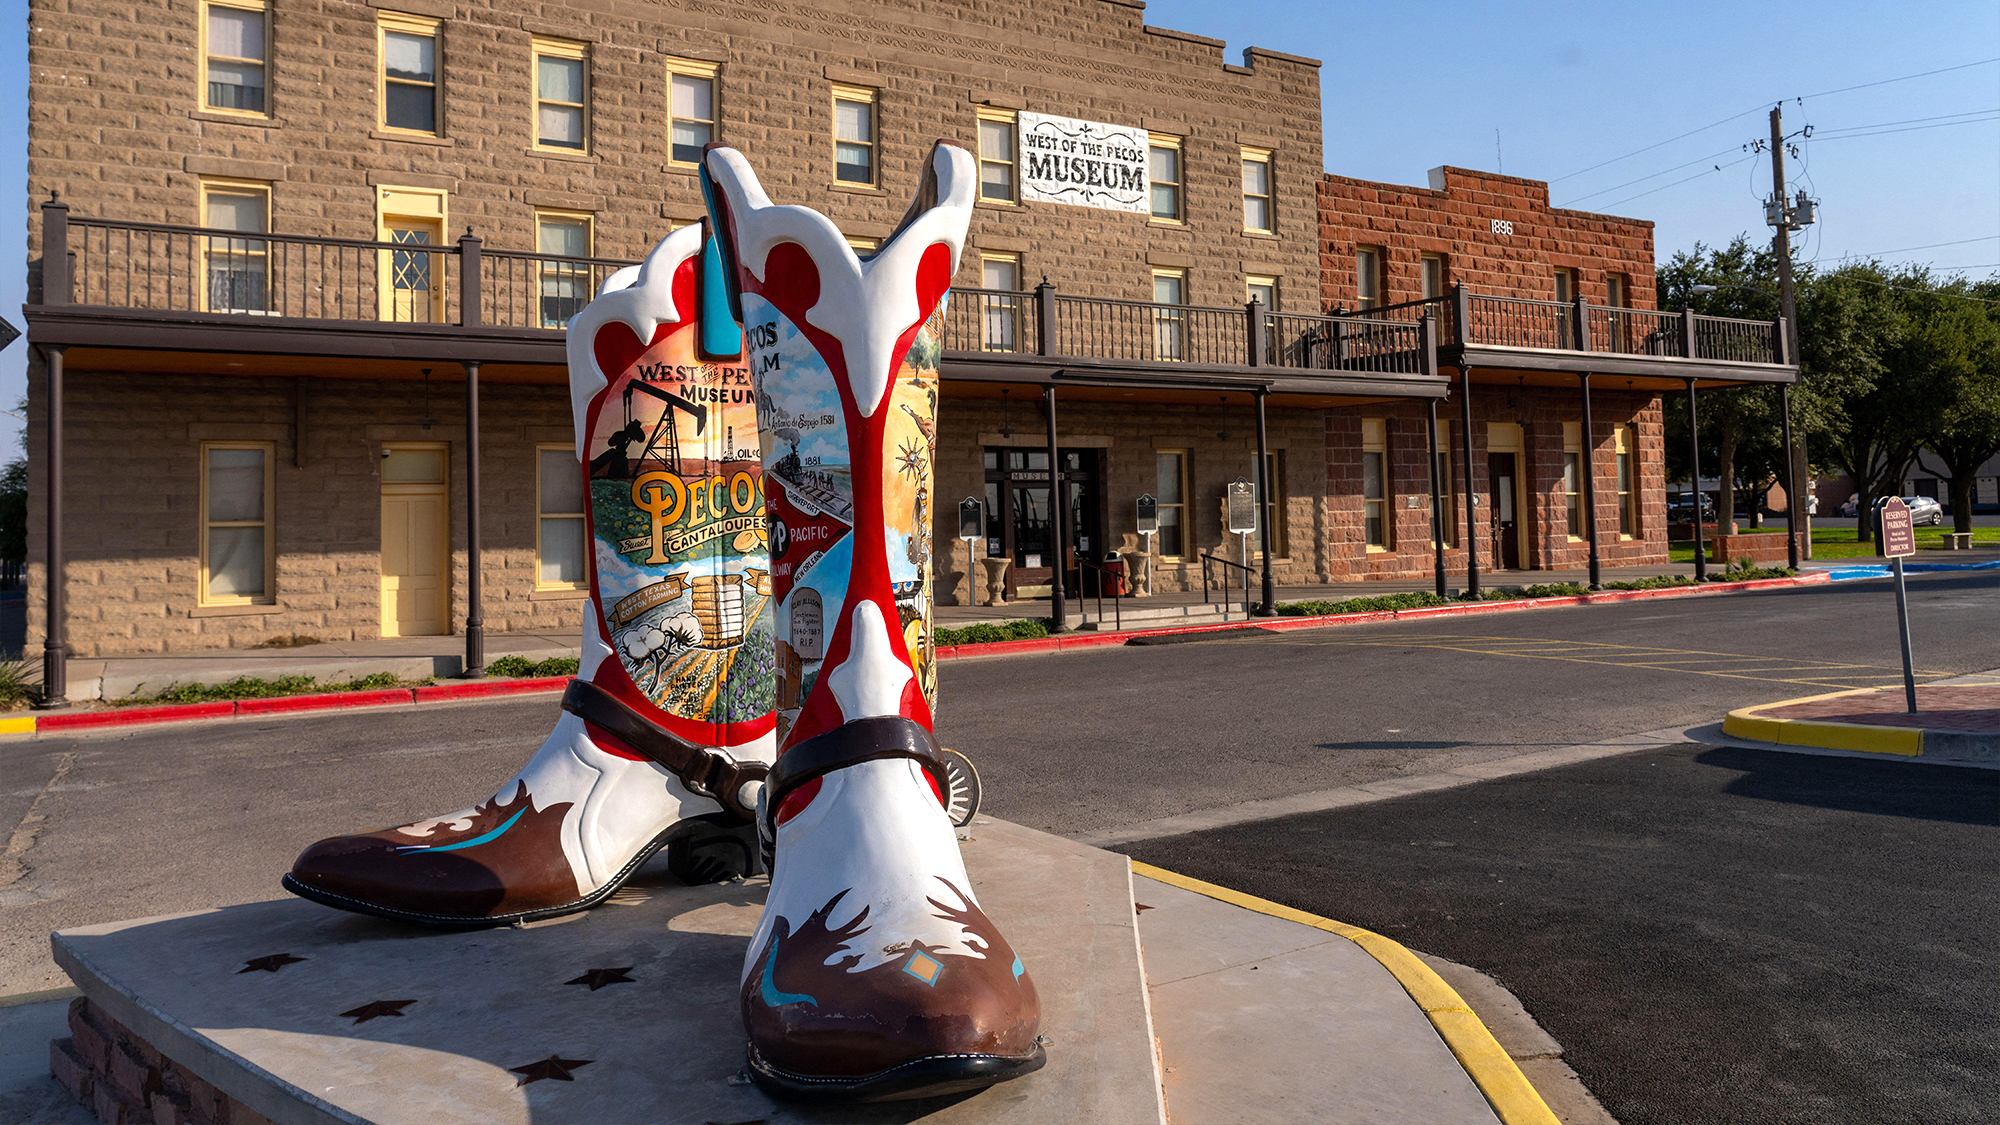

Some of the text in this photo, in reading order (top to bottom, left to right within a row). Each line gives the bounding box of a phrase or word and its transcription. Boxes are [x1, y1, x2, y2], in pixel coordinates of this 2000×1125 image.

[1026, 134, 1144, 163] WEST OF THE PECOS
[1026, 151, 1145, 192] MUSEUM
[1491, 219, 1513, 235] 1896
[637, 361, 698, 383] WEST
[702, 366, 719, 382] THE
[722, 367, 752, 386] PE
[792, 417, 798, 427] de
[820, 415, 835, 426] 1581
[804, 456, 821, 466] 1881
[1013, 472, 1063, 480] MUSEM
[767, 499, 778, 511] THE
[1885, 510, 1908, 520] RESERVED
[1887, 520, 1908, 529] PARKING
[790, 525, 828, 542] PACIFIC
[623, 537, 650, 551] Sweet
[794, 569, 805, 583] NEW
[620, 587, 679, 618] COTTON FARMING
[621, 582, 671, 609] WEST TEXAS
[791, 598, 821, 610] CLAY ALLISON
[670, 681, 702, 690] PAINTED
